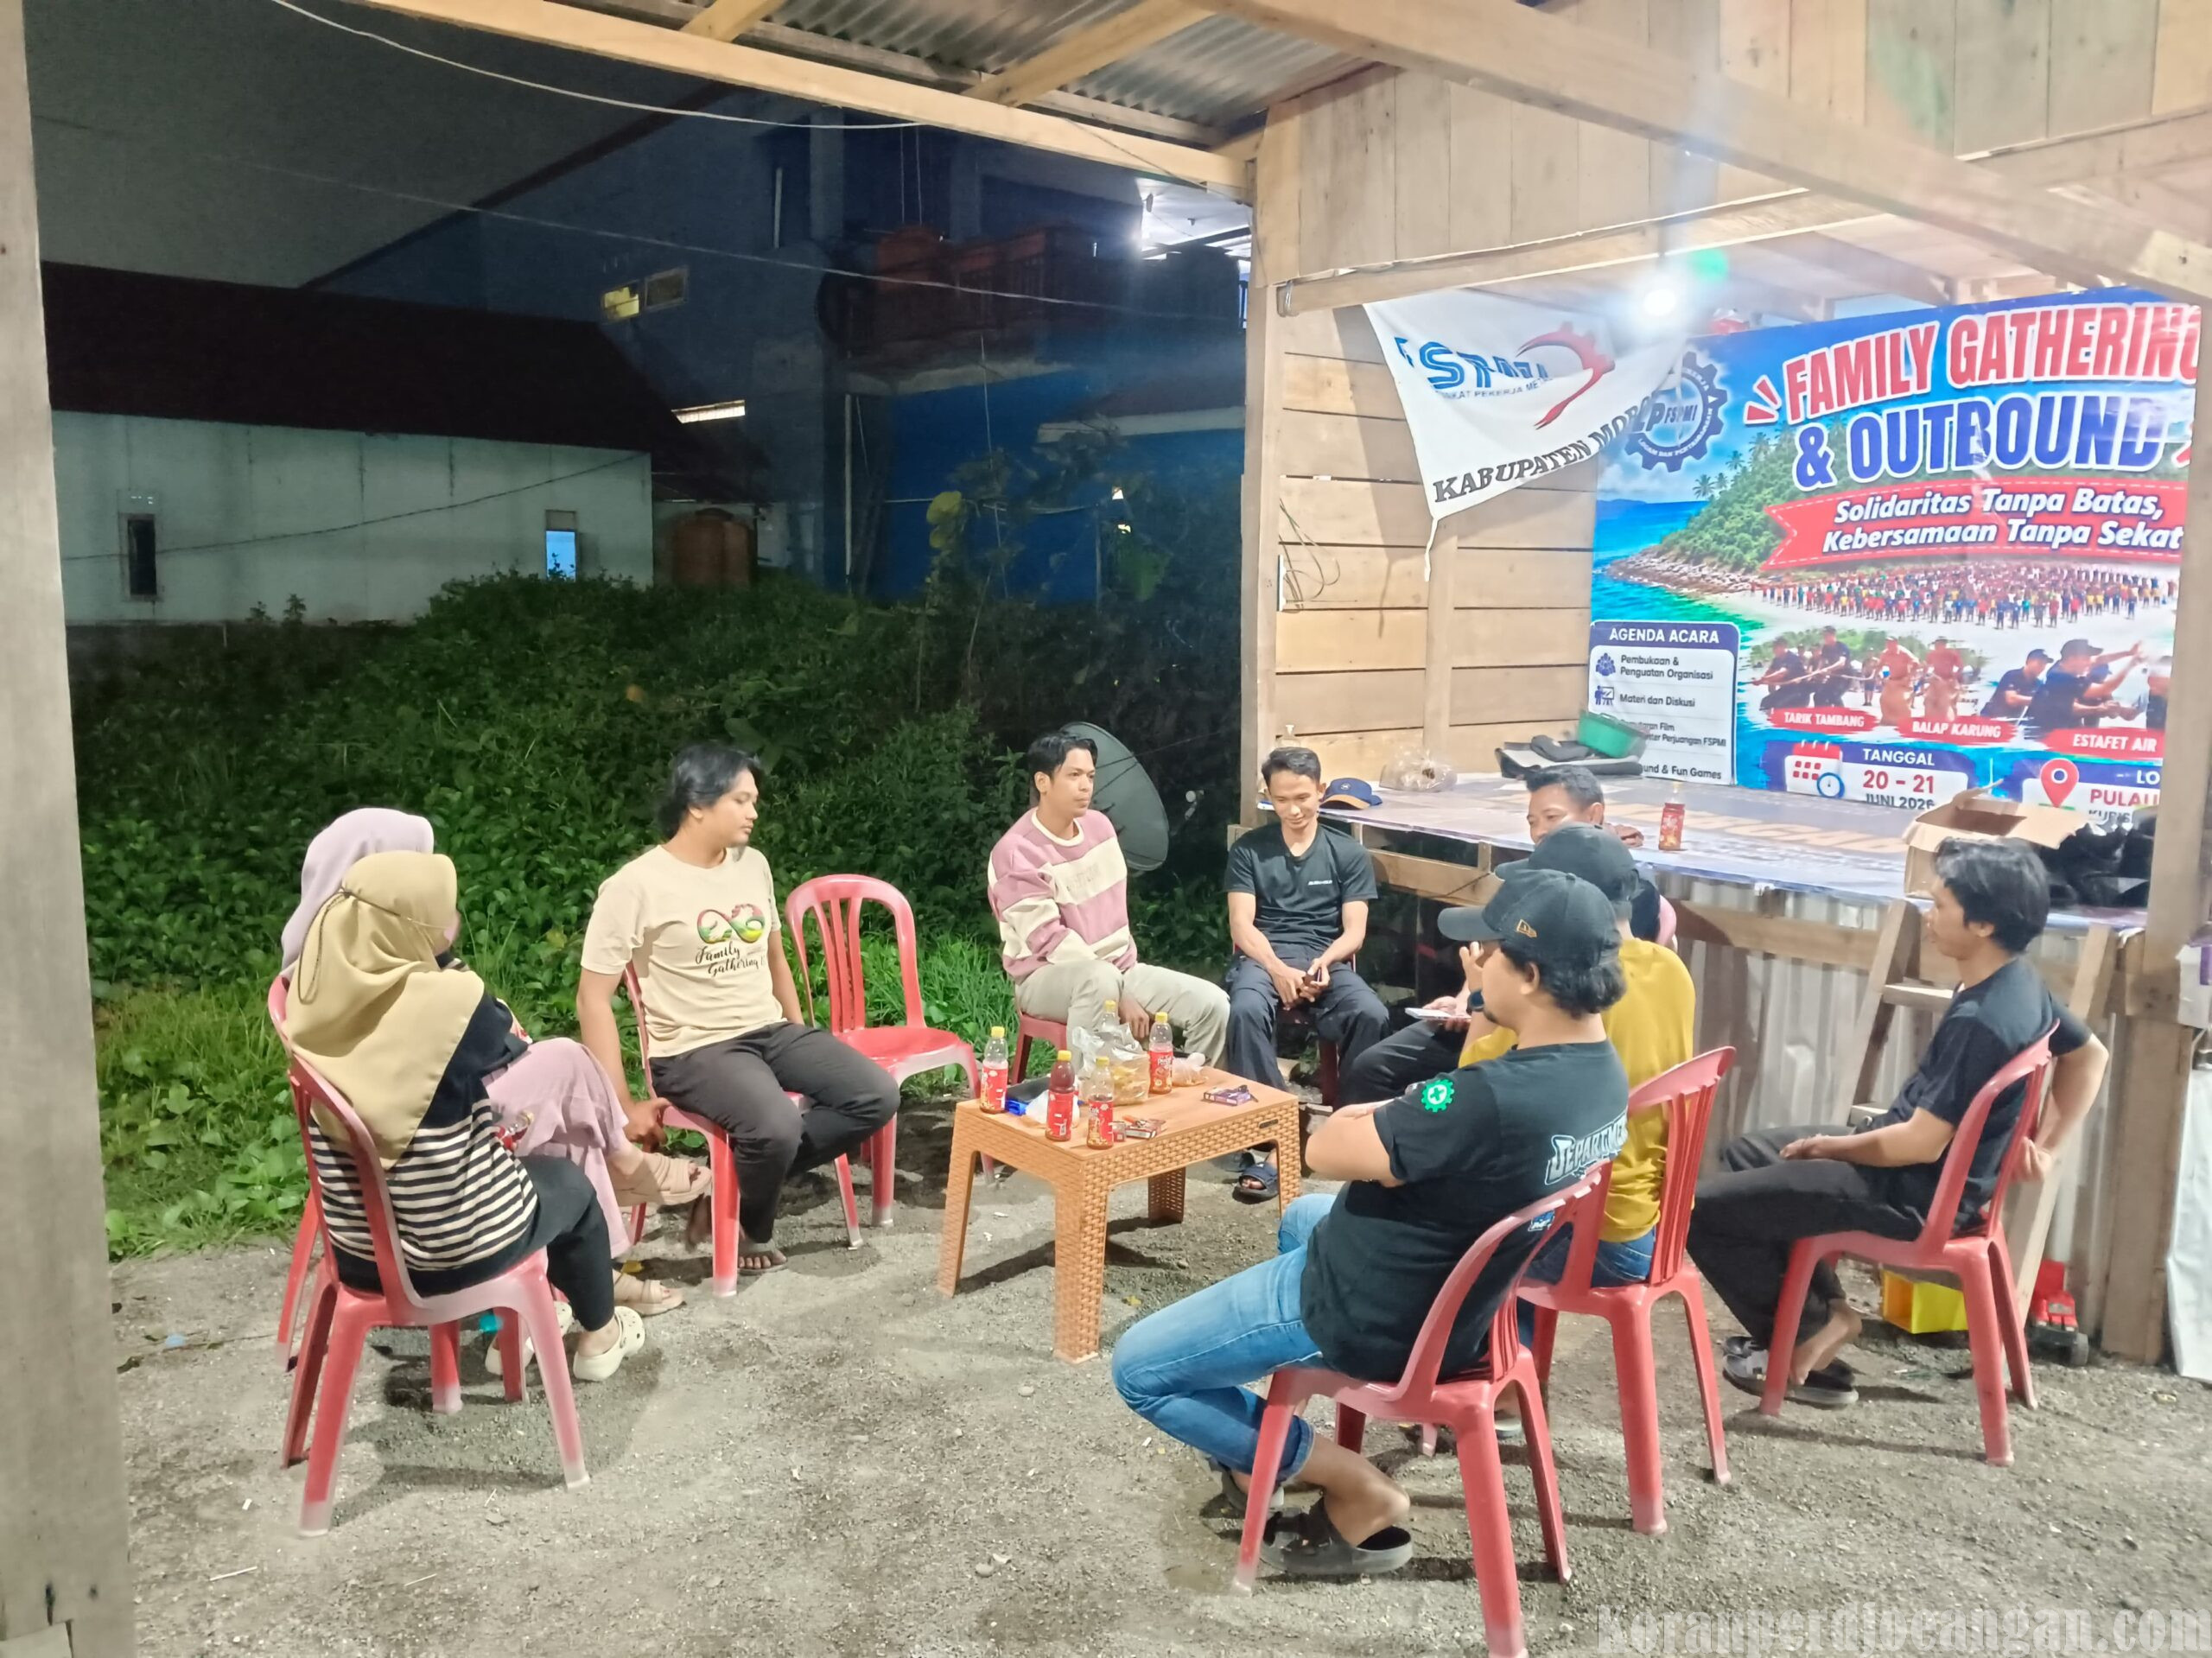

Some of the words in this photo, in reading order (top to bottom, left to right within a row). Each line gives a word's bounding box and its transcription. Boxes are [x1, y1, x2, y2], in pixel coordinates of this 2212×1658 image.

[1786, 324, 1936, 422] FAMILY
[1796, 426, 1834, 489] &
[1849, 395, 2164, 480] OUTBOUND
[1432, 440, 1592, 503] KABUPATEN
[1834, 492, 1973, 524] Solidaritas
[1982, 489, 2065, 517] Tanpa
[2072, 487, 2164, 520] Batas,
[1822, 523, 1998, 552] Kebersamaan
[2006, 519, 2091, 549] Tanpa
[2098, 521, 2183, 549] Sekat
[1609, 627, 1665, 642] AGENDA
[1669, 629, 1719, 644] ACARA
[1621, 655, 1671, 665] Pembukaan
[1673, 657, 1679, 666] &
[1620, 667, 1665, 679] Penguatan
[1667, 669, 1713, 680] Organisasi
[1619, 694, 1645, 704] Materi
[1647, 695, 1663, 705] dan
[1666, 696, 1695, 708] Diskusi
[1783, 711, 1812, 724] TARIK
[1815, 714, 1865, 727] TAMBANG
[1912, 721, 1948, 734] BALAP
[1951, 723, 2001, 738] KARUNG
[1662, 734, 1701, 746] Perjuangan
[2073, 733, 2130, 750] ESTAFET
[2131, 736, 2158, 753] AIR
[1863, 748, 1935, 765] TANGGAL
[1662, 765, 1669, 774] &
[1672, 765, 1688, 776] Fun
[1690, 768, 1722, 779] Games
[1863, 769, 1889, 790] 20
[1912, 773, 1934, 794] 21
[695, 941, 741, 965] Family
[708, 956, 760, 978] Gathering
